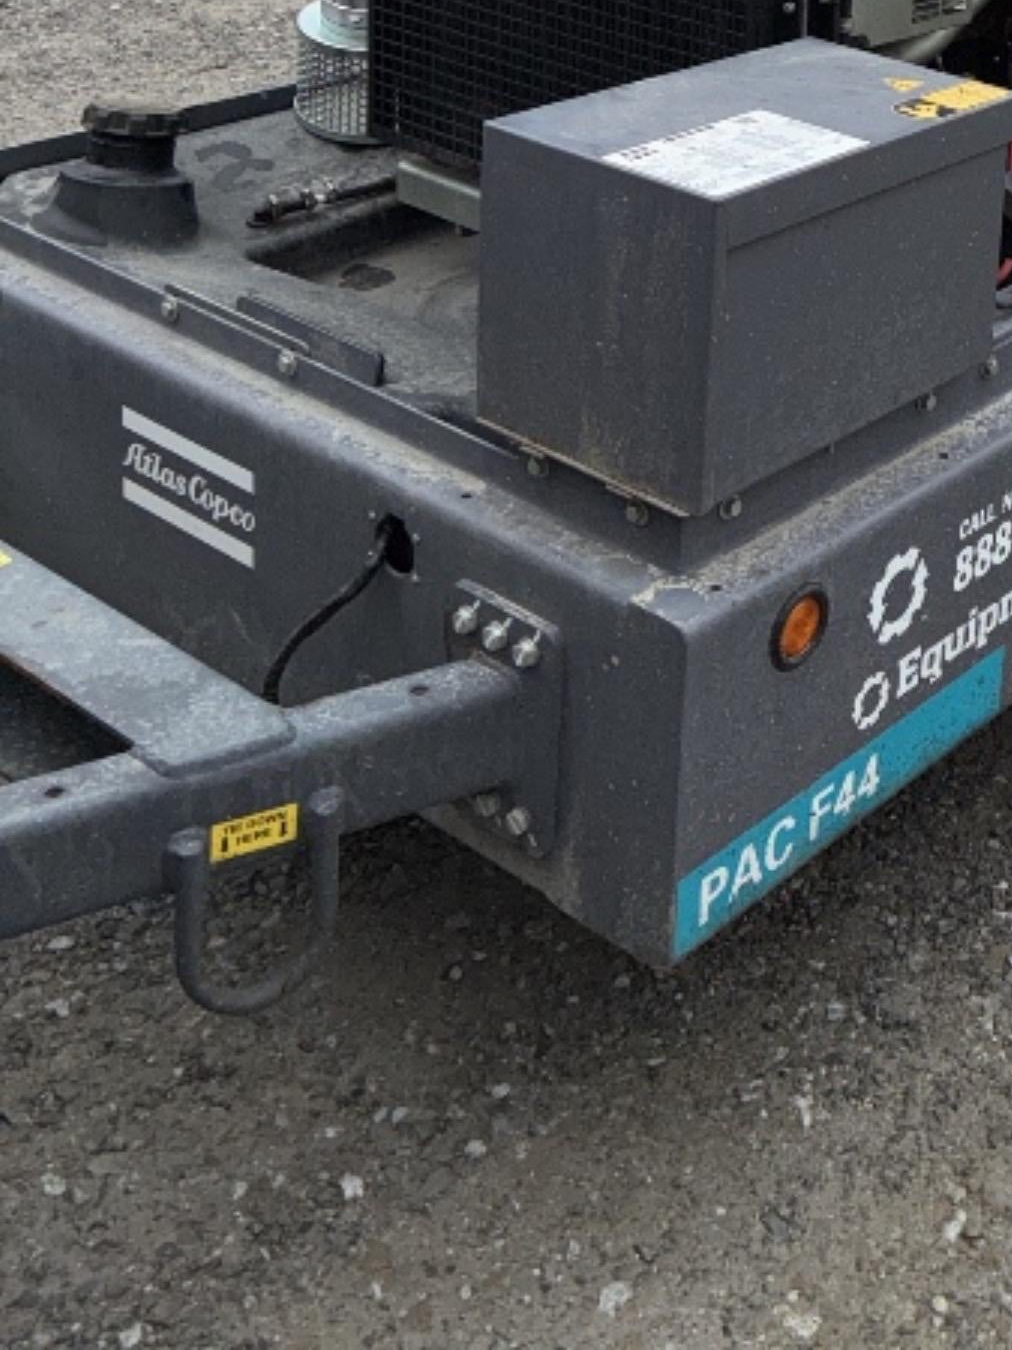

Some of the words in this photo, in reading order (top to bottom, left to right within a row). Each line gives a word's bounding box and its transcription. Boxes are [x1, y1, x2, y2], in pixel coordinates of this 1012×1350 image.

[121, 443, 187, 496] Atlas
[188, 476, 256, 533] Copco
[958, 503, 998, 531] CALL
[697, 815, 797, 927] PAC
[808, 752, 881, 842] F44
